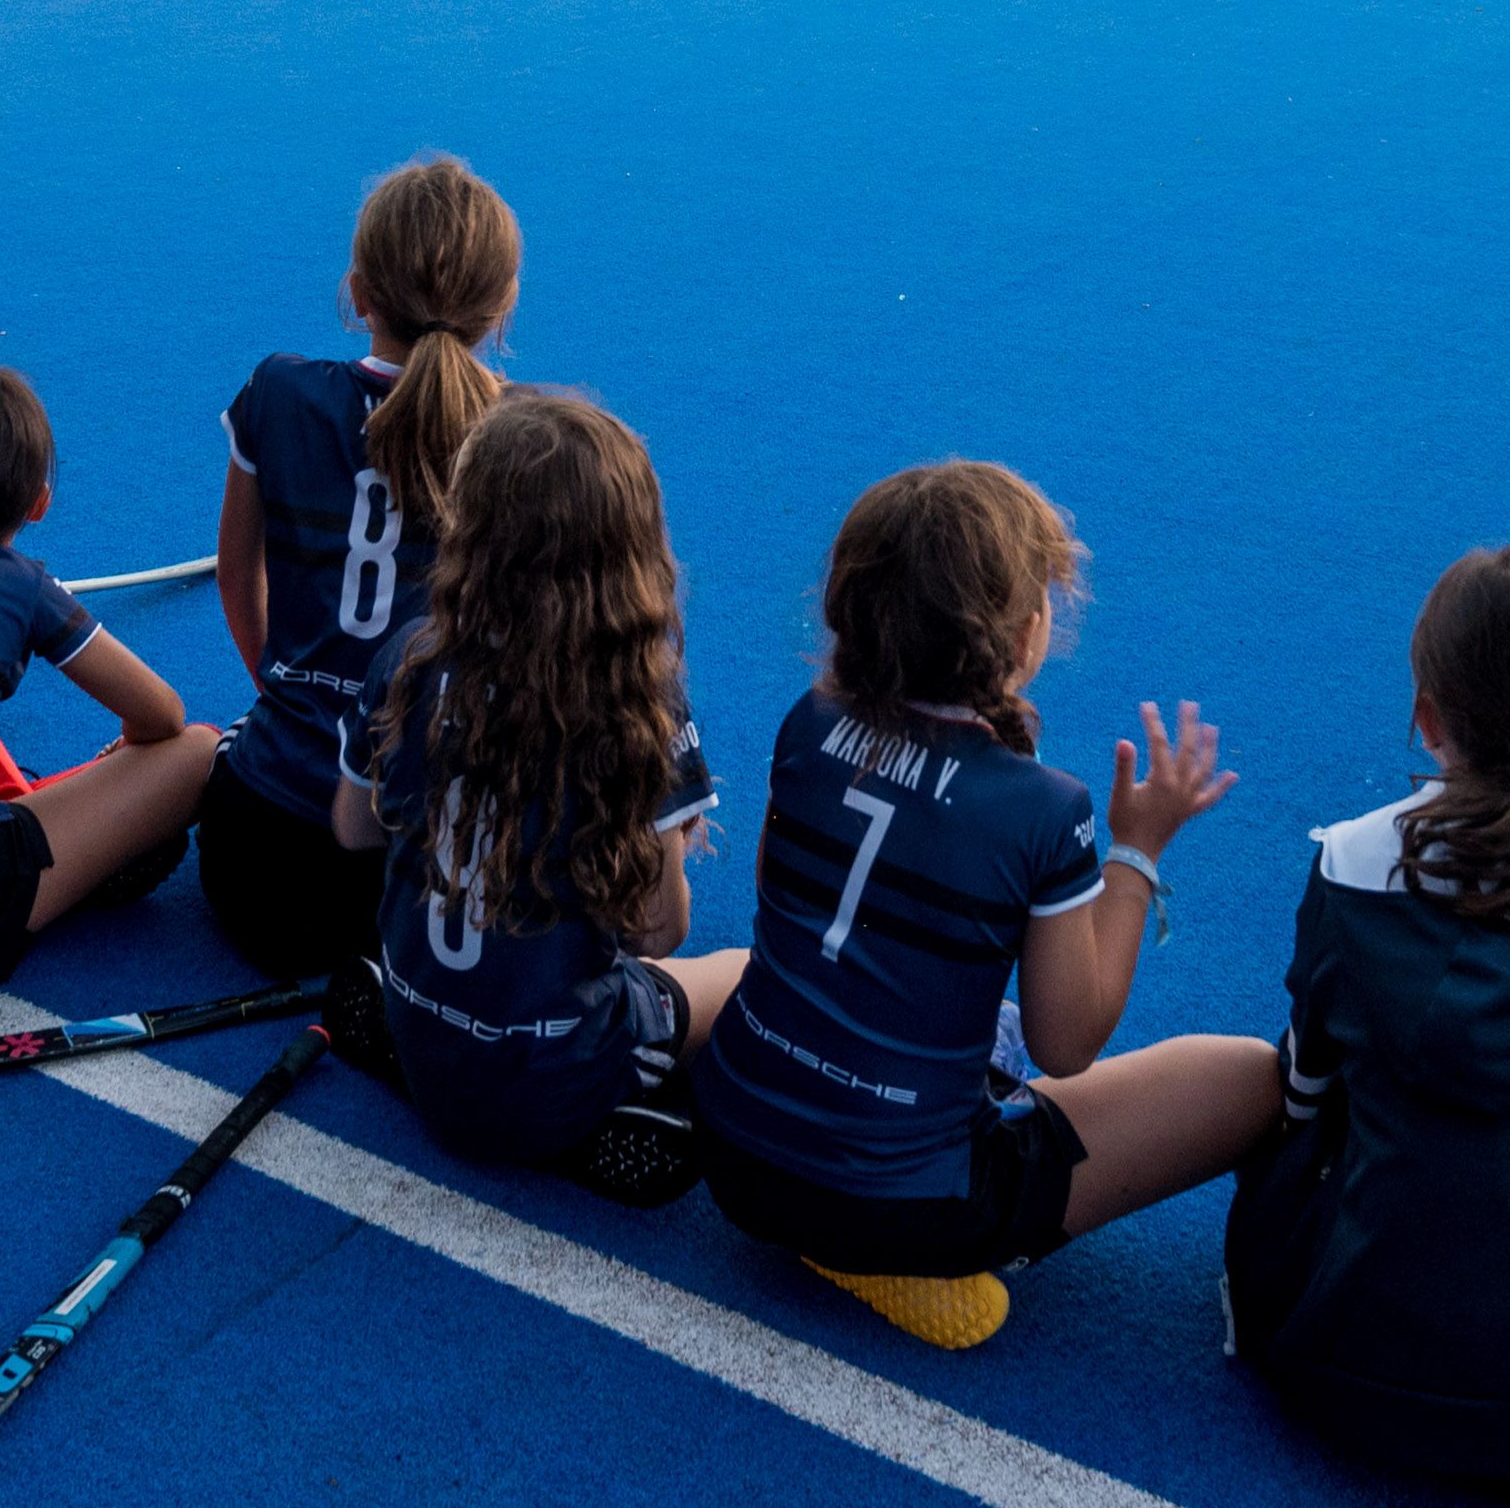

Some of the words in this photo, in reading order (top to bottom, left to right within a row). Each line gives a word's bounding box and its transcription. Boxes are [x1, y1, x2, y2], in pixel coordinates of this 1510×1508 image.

[339, 467, 403, 640] 8
[270, 661, 365, 697] PORS
[934, 756, 961, 805] V.
[821, 786, 896, 963] 7
[738, 995, 918, 1106] ORSCHE
